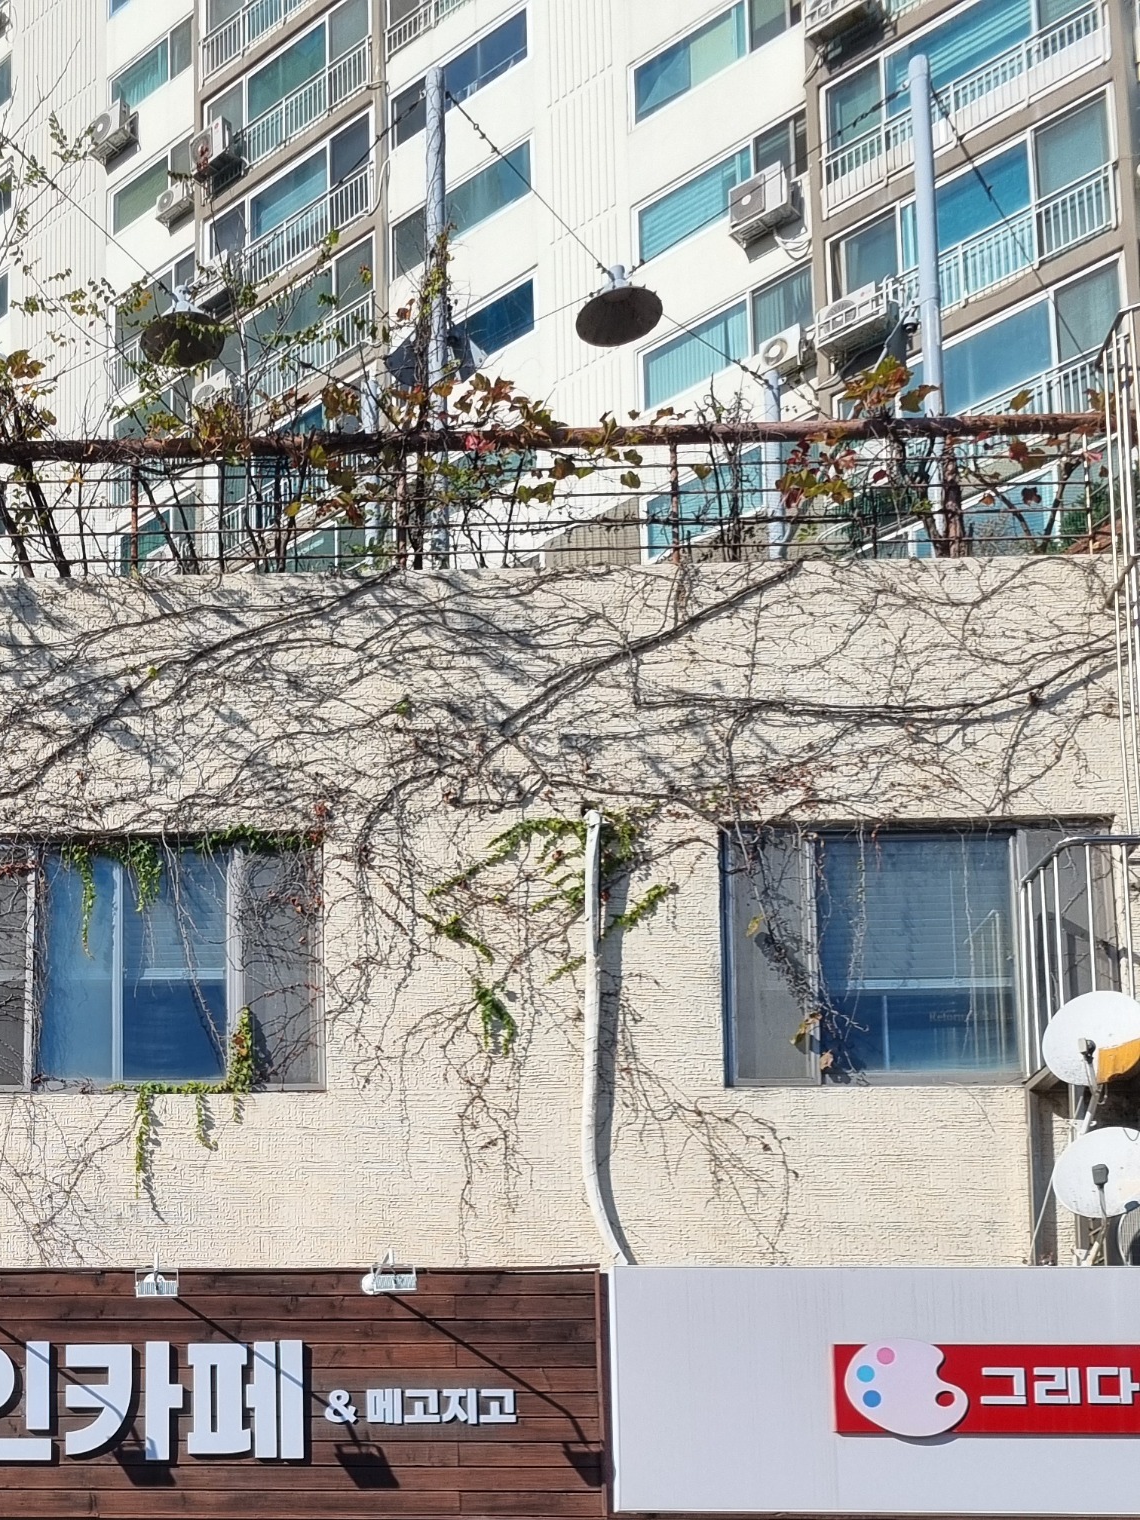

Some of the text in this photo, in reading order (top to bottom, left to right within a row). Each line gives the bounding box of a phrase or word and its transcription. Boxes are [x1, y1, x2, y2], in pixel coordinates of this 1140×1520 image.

[980, 1366, 1140, 1405] 그리다
[325, 1389, 358, 1424] &
[366, 1388, 517, 1424] 메고지고
